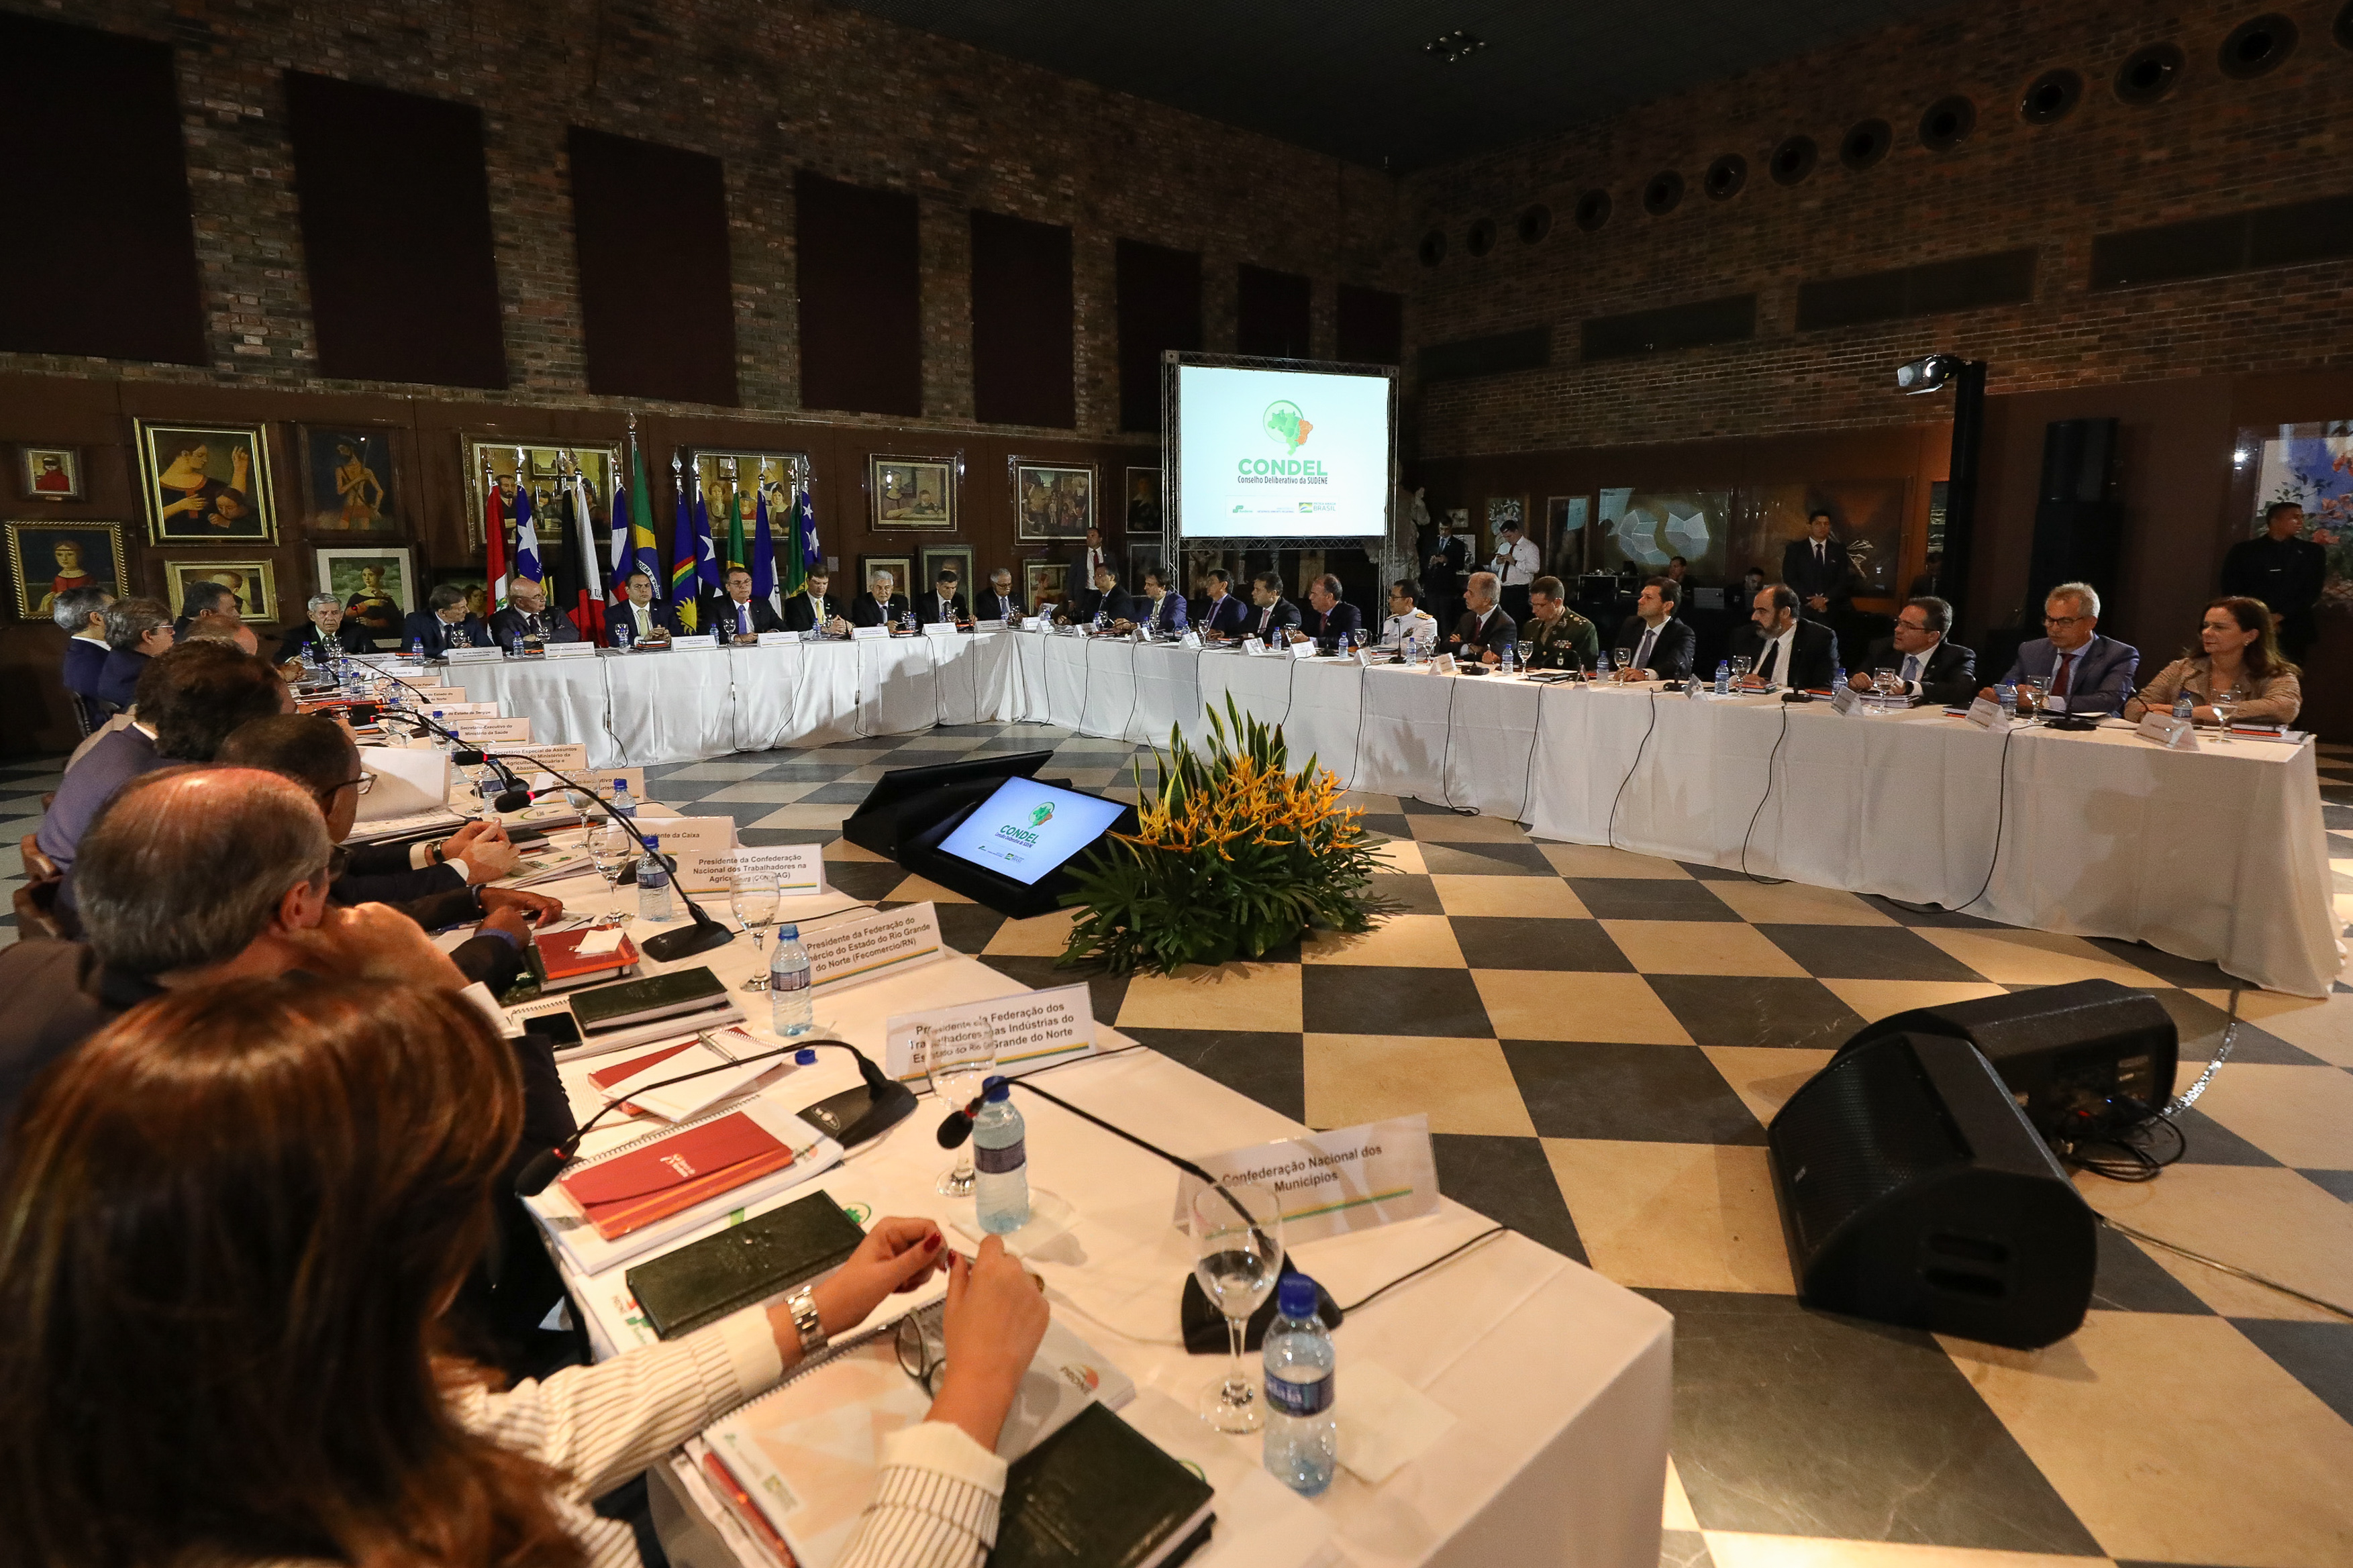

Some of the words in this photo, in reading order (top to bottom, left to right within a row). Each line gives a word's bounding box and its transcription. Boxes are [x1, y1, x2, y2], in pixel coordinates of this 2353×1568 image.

[1238, 458, 1328, 476] CONDEL
[1238, 476, 1263, 484] Conselho
[1000, 825, 1039, 844] CONDEL
[693, 866, 726, 874] Nacional
[728, 865, 741, 873] dos
[743, 863, 795, 872] Trabalhadores
[699, 856, 738, 866] Presidente
[751, 854, 801, 864] Confederação
[807, 935, 850, 951] Presidente
[852, 931, 862, 939] da
[864, 920, 903, 936] Federação
[905, 917, 915, 925] do
[809, 949, 834, 961] mércio
[836, 946, 846, 954] do
[848, 939, 876, 951] Estado
[878, 935, 888, 944] do
[889, 930, 903, 940] Rio
[903, 923, 930, 936] Grande
[815, 963, 826, 972] do
[828, 956, 851, 968] Norte
[852, 937, 916, 963] (Fecomercio/RN)
[991, 1005, 1043, 1023] Federação
[1046, 1003, 1064, 1013] dos
[1009, 1016, 1058, 1033] Indústrias
[1062, 1014, 1074, 1023] do
[1031, 1033, 1043, 1043] do
[1046, 1027, 1073, 1040] Norte
[1222, 1161, 1305, 1186] Confederação
[1308, 1149, 1358, 1169] Nacional
[1361, 1144, 1383, 1158] dos
[1274, 1171, 1338, 1194] Municípios
